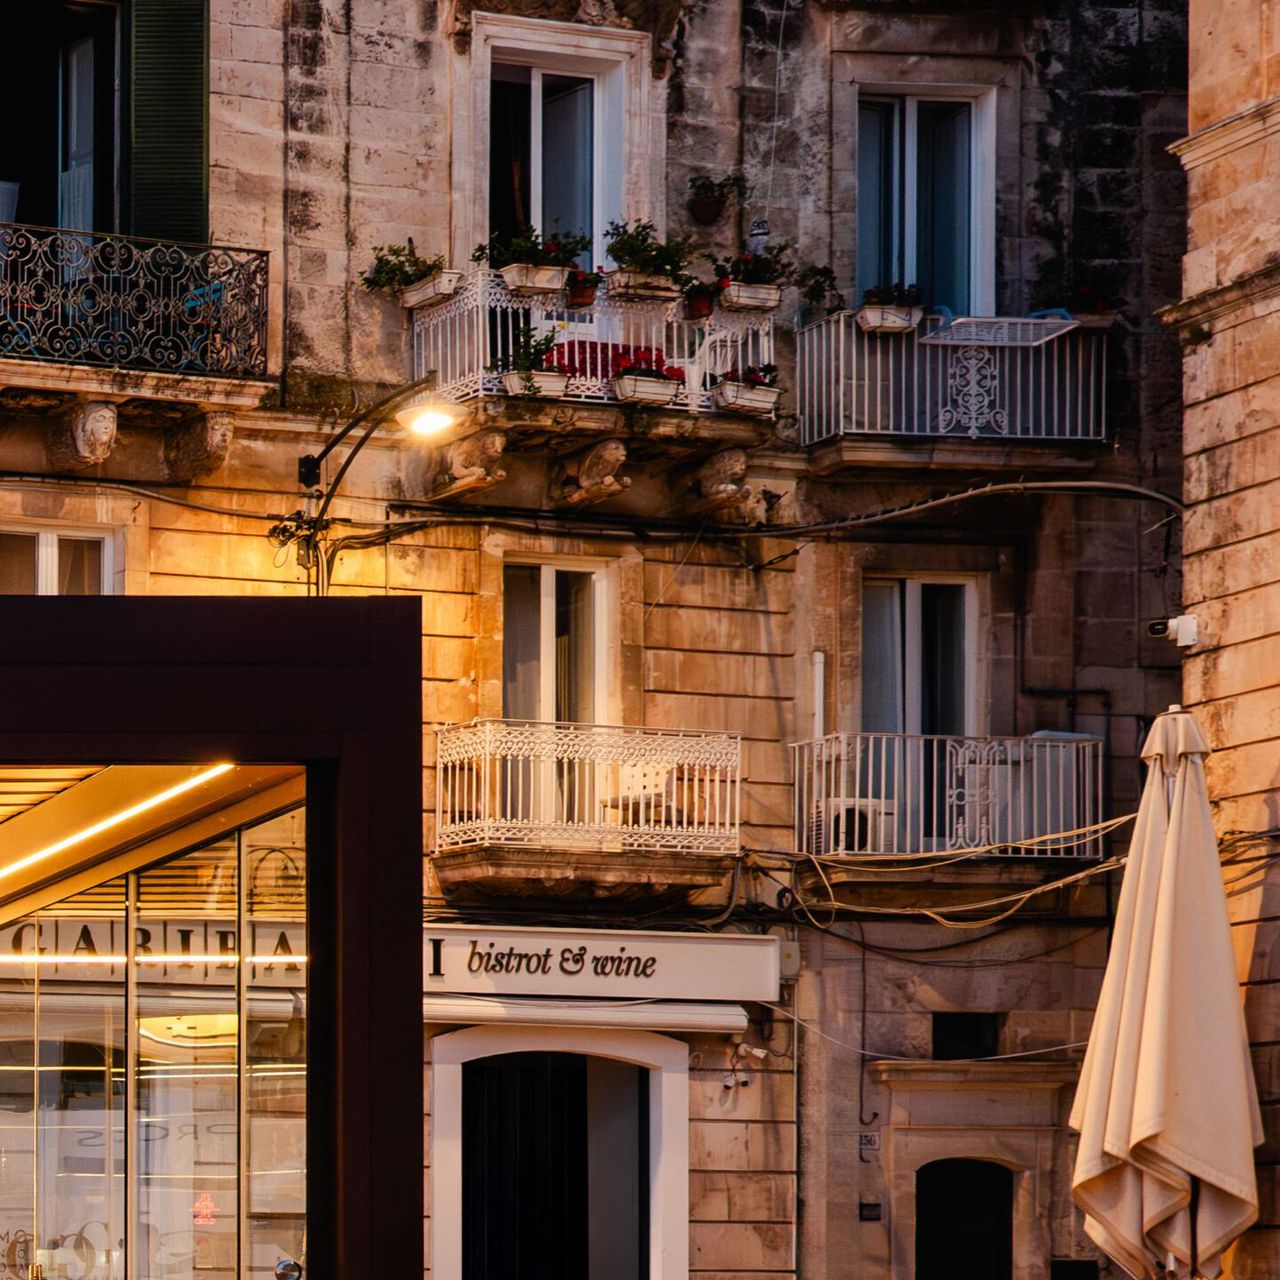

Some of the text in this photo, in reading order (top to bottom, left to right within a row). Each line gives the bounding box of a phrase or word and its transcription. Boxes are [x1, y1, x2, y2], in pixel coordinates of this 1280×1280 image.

[467, 940, 553, 974] bistrot
[559, 946, 588, 976] &
[591, 947, 657, 978] wine
